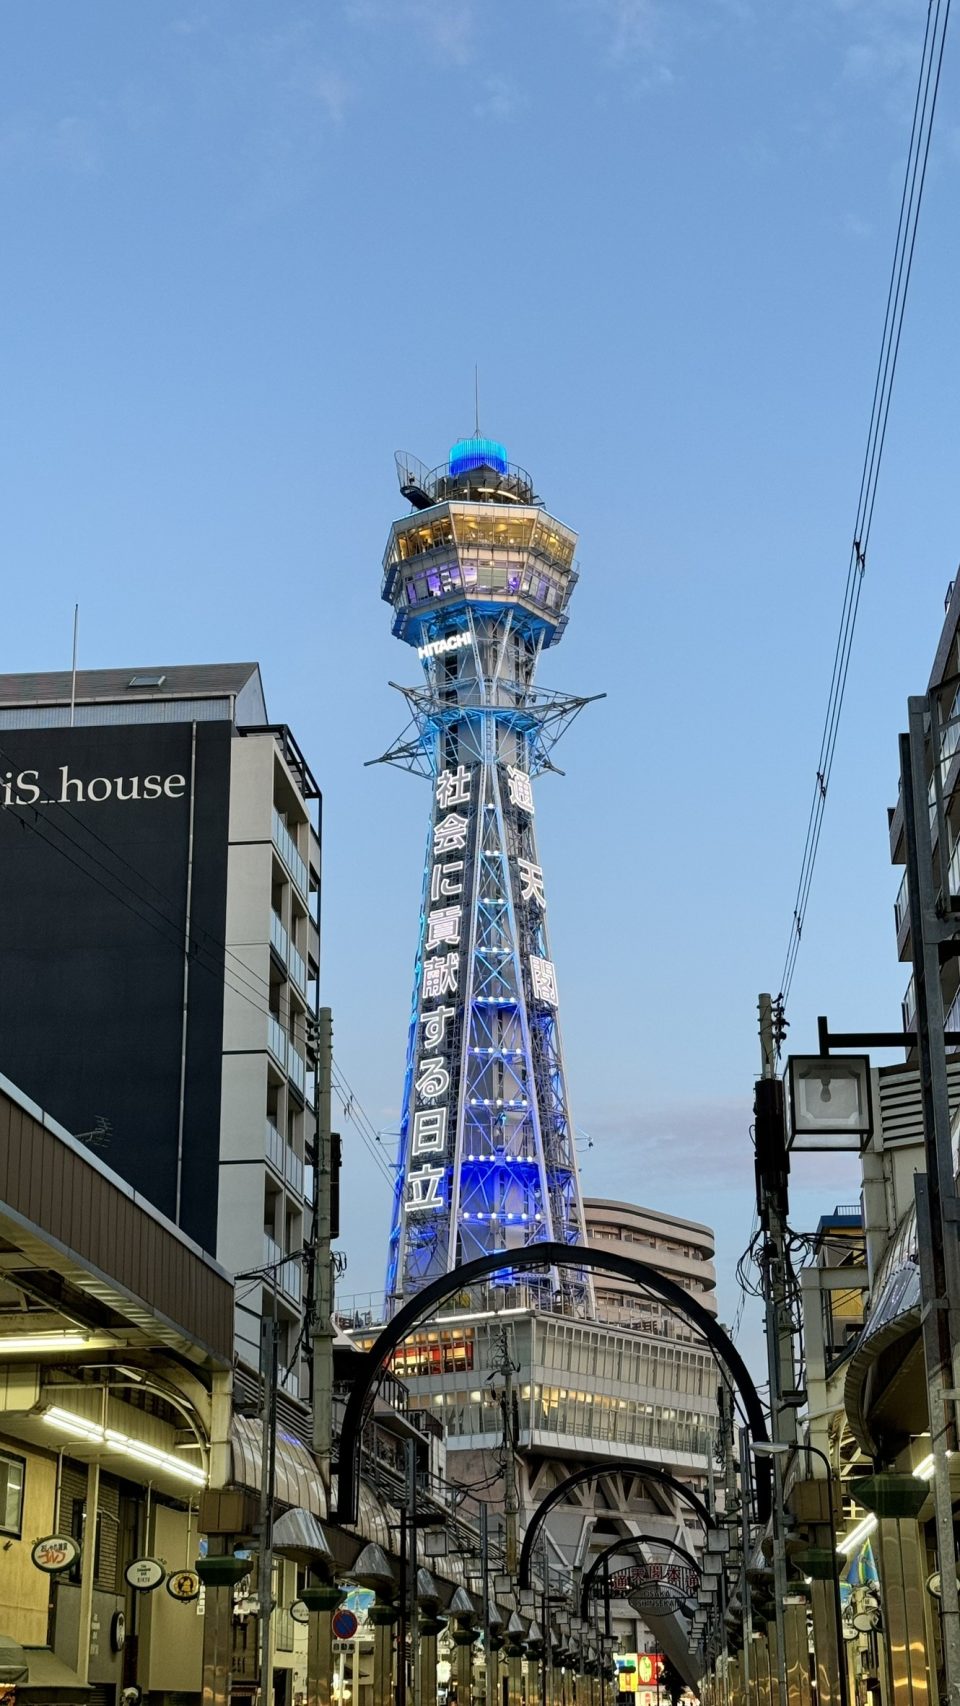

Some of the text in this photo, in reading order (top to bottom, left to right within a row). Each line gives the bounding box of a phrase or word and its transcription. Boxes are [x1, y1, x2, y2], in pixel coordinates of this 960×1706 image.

[417, 631, 472, 659] HITACHI
[405, 765, 472, 1212] 社会に貢献する日立
[507, 764, 559, 1007] 通天閣
